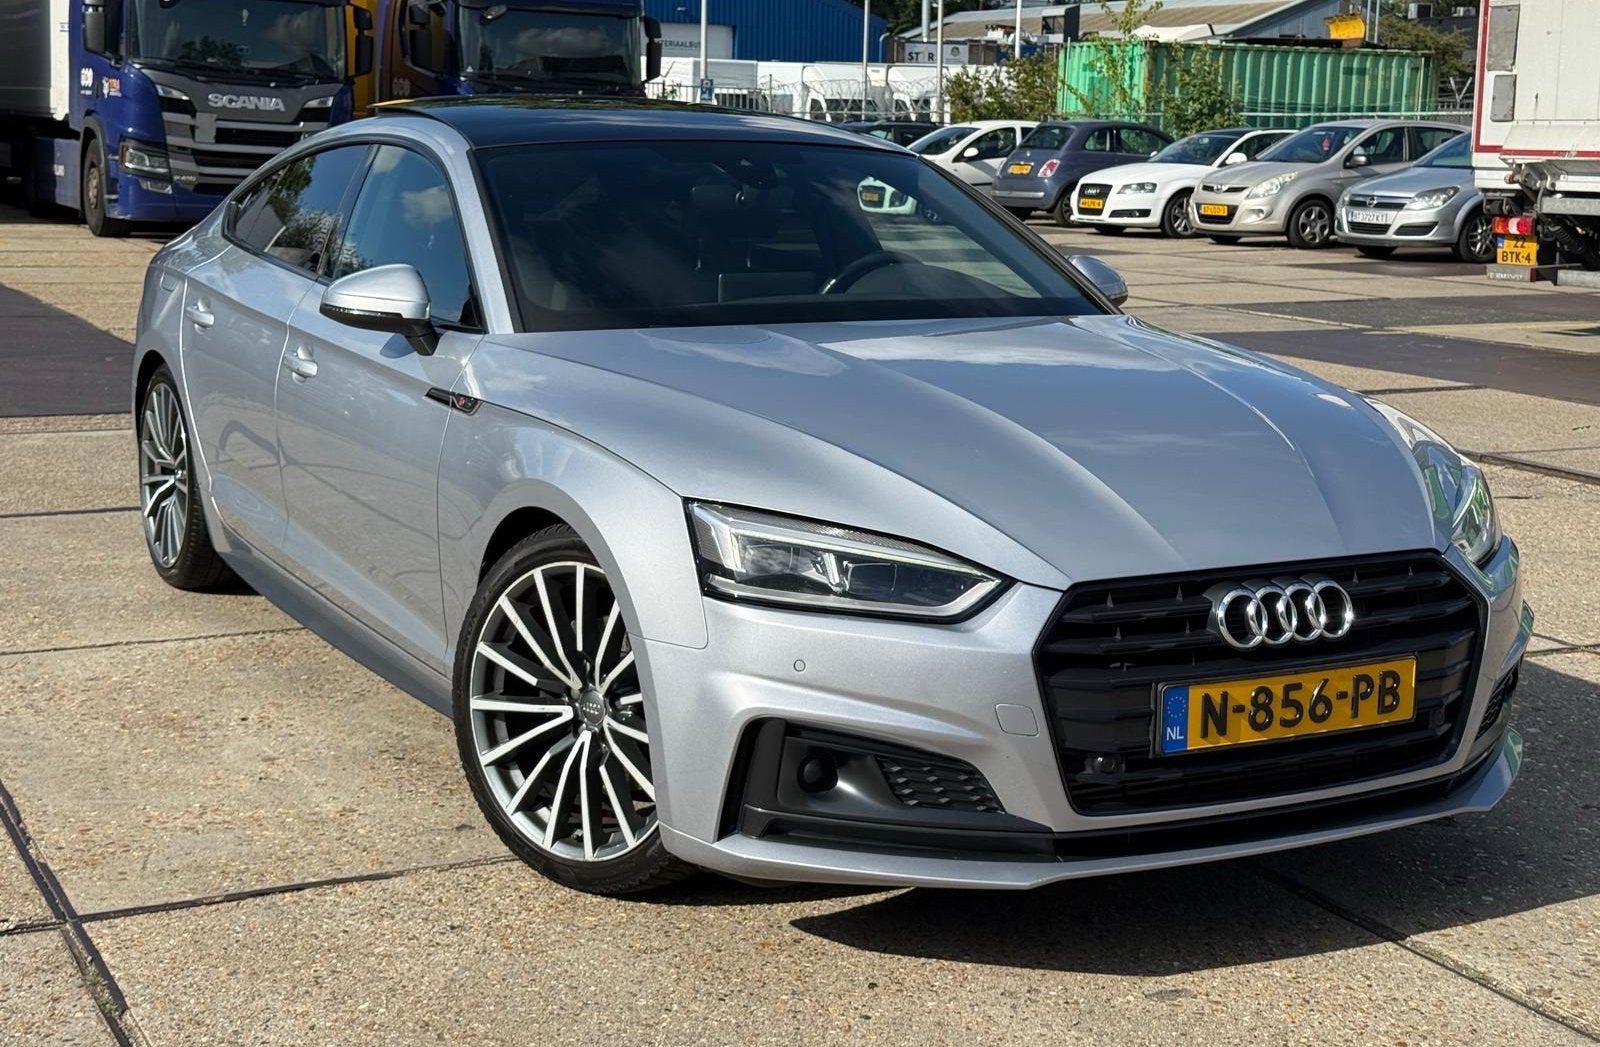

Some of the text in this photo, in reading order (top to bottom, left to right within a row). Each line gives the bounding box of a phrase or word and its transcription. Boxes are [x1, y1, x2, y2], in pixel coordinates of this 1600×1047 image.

[207, 93, 286, 112] SCANIA
[1512, 235, 1526, 248] 22
[1501, 251, 1531, 264] BTK-4
[1200, 669, 1401, 739] N-856-PB
[1166, 726, 1185, 741] NL
